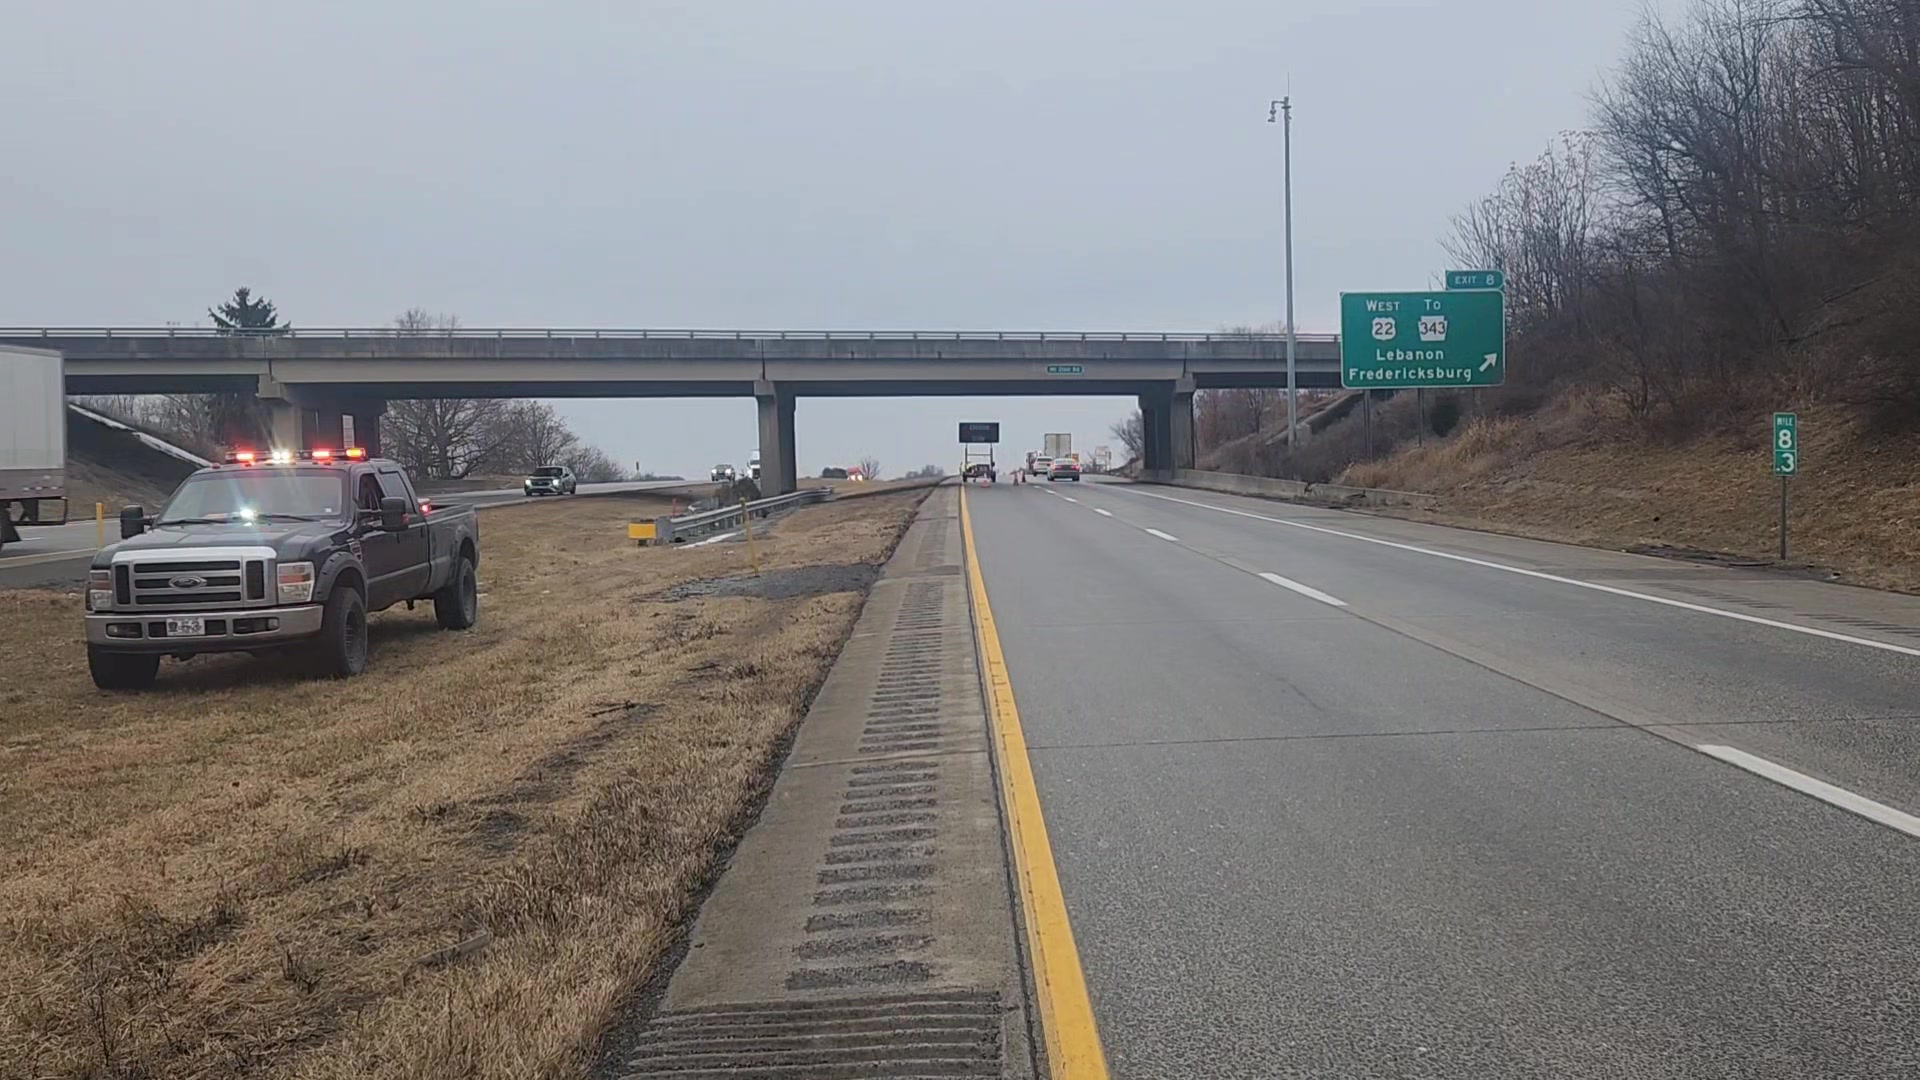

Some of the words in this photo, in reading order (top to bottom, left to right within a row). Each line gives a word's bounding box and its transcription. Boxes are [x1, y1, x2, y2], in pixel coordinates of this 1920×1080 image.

[1455, 275, 1477, 284] EXIT
[1486, 274, 1495, 285] 8
[1366, 300, 1400, 311] WEST
[1374, 322, 1393, 335] 22
[1420, 322, 1446, 335] 343
[1376, 349, 1444, 361] Lebanon
[1350, 367, 1471, 382] Fredericksburg
[1777, 417, 1793, 426] MILE
[1778, 429, 1792, 449] 8
